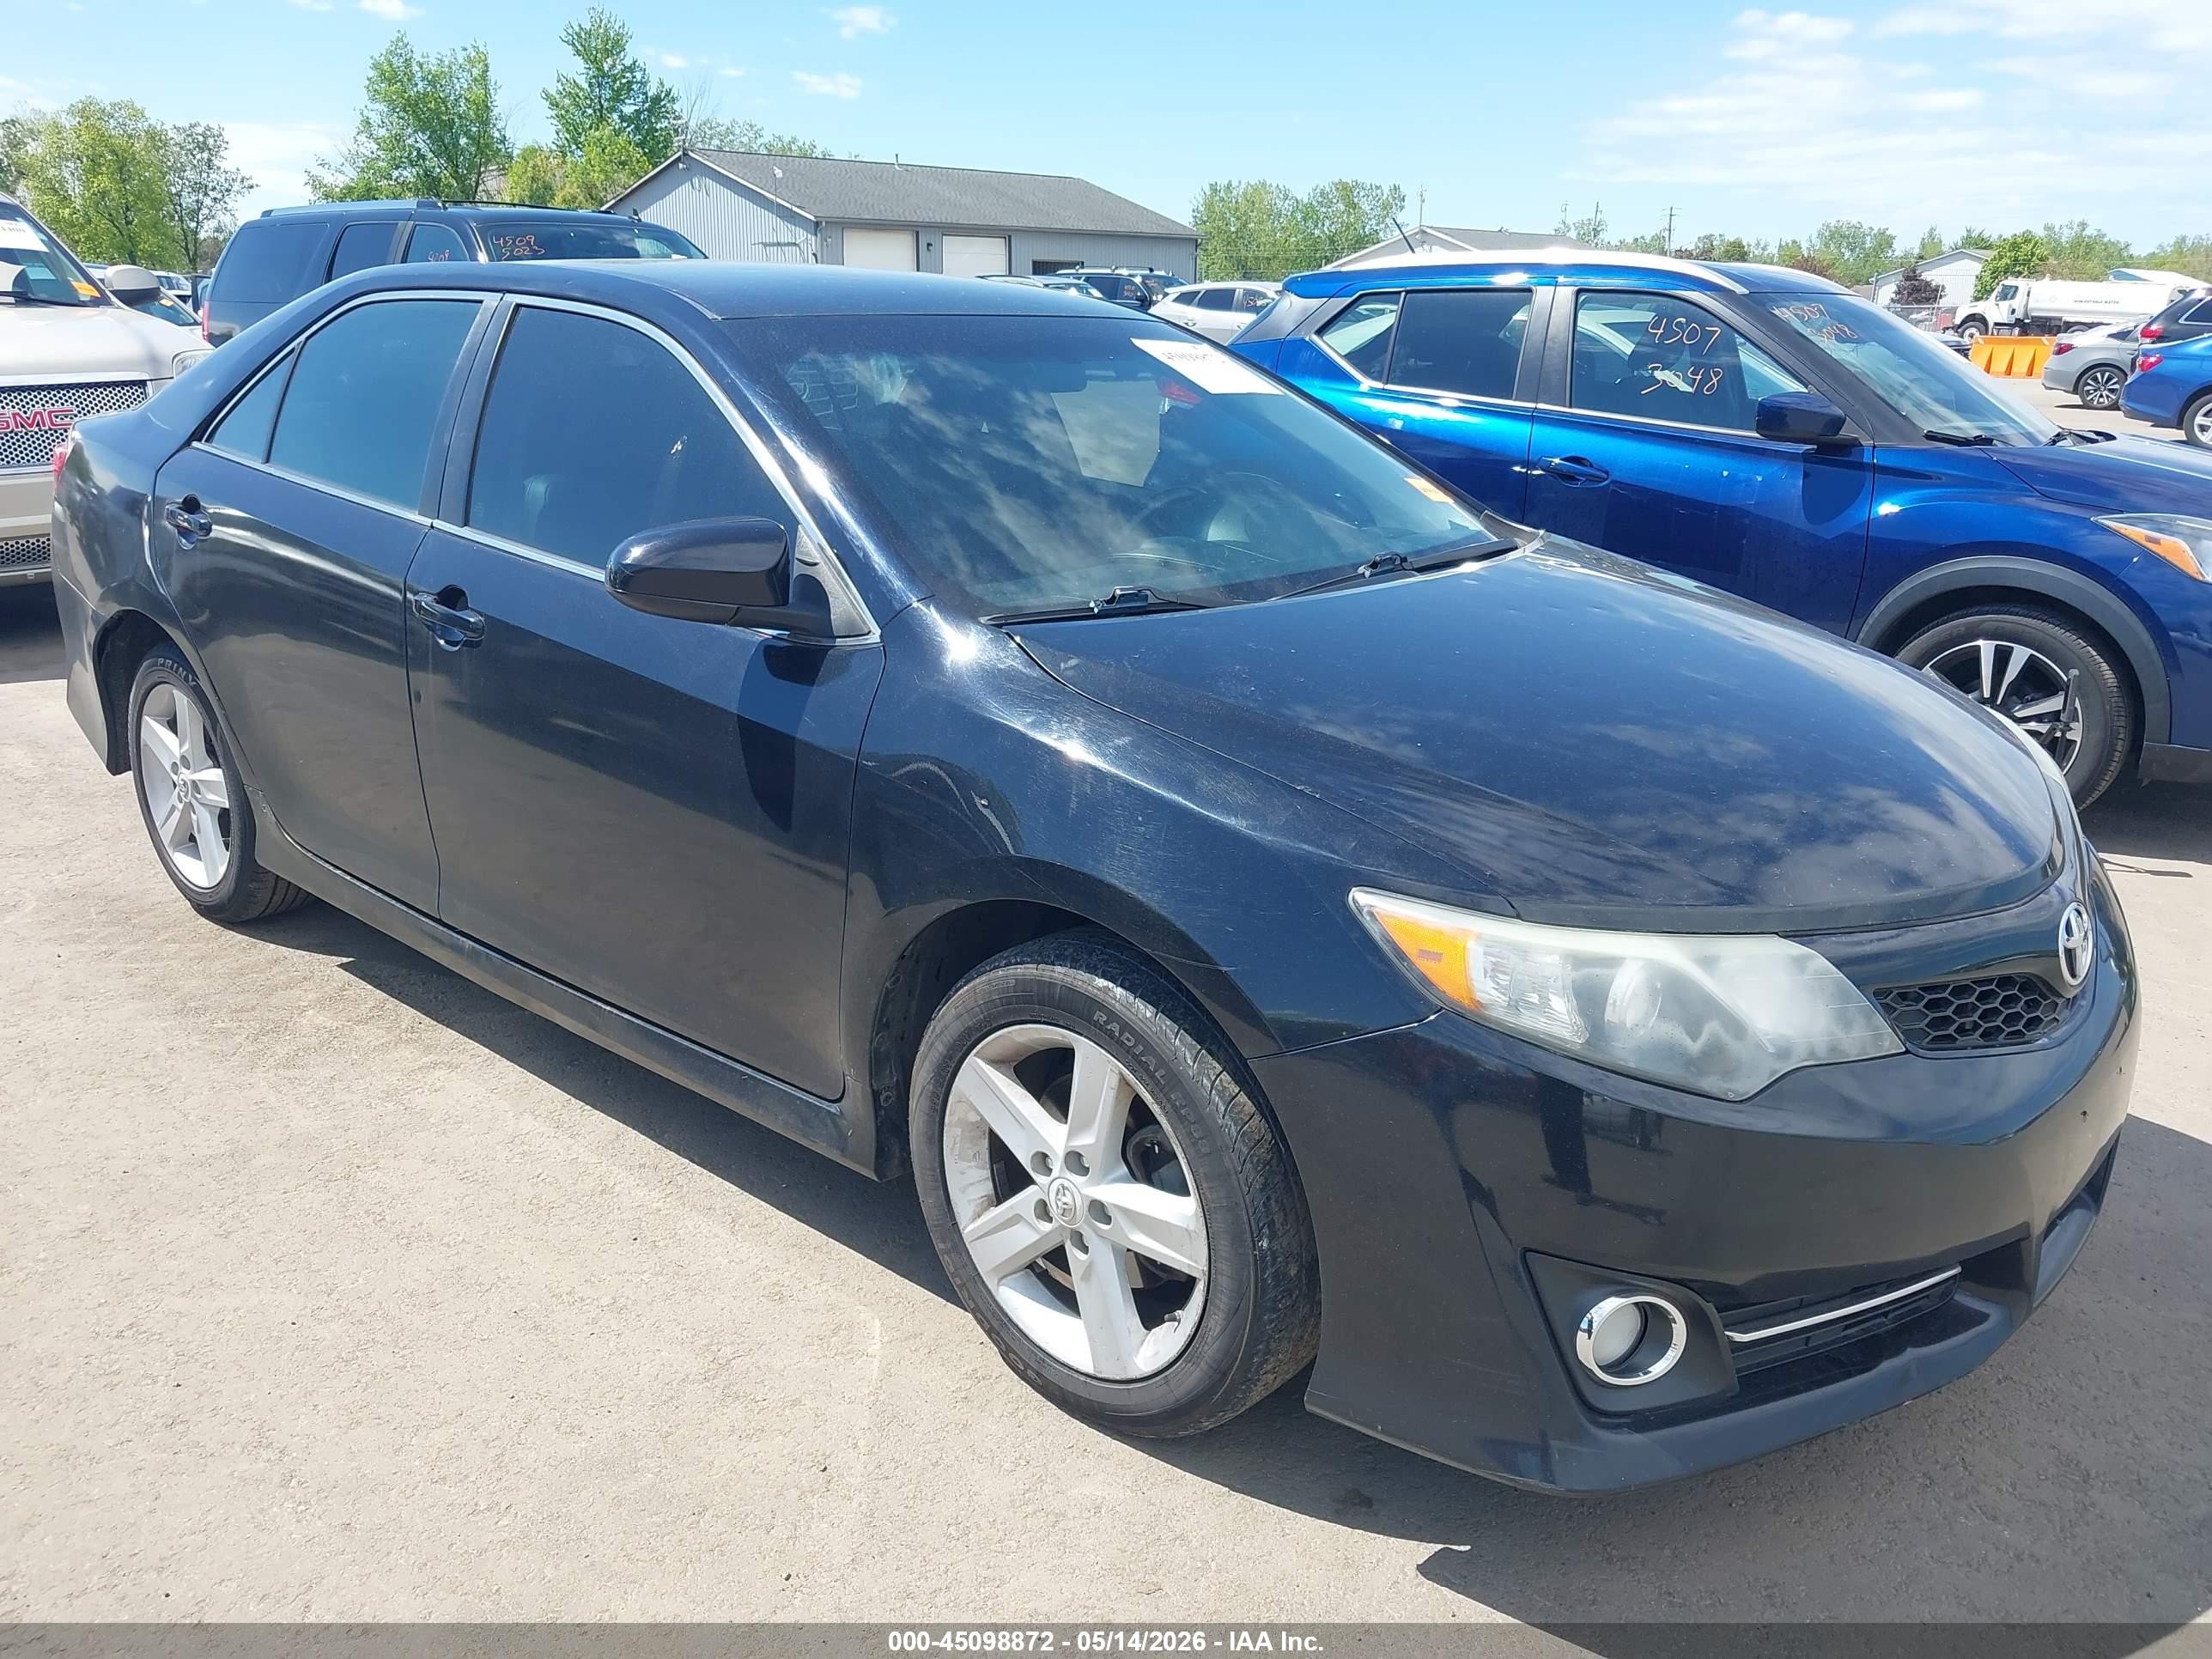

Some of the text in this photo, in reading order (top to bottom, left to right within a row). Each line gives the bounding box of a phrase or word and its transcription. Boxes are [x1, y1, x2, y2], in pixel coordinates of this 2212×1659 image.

[493, 234, 536, 247] 4509
[501, 246, 546, 261] 5023
[1770, 304, 1830, 325] 4507
[1648, 316, 1722, 356] 4507
[1807, 324, 1859, 344] 3048
[1641, 363, 1723, 395] 3048
[1093, 1010, 1166, 1085] RADIAL
